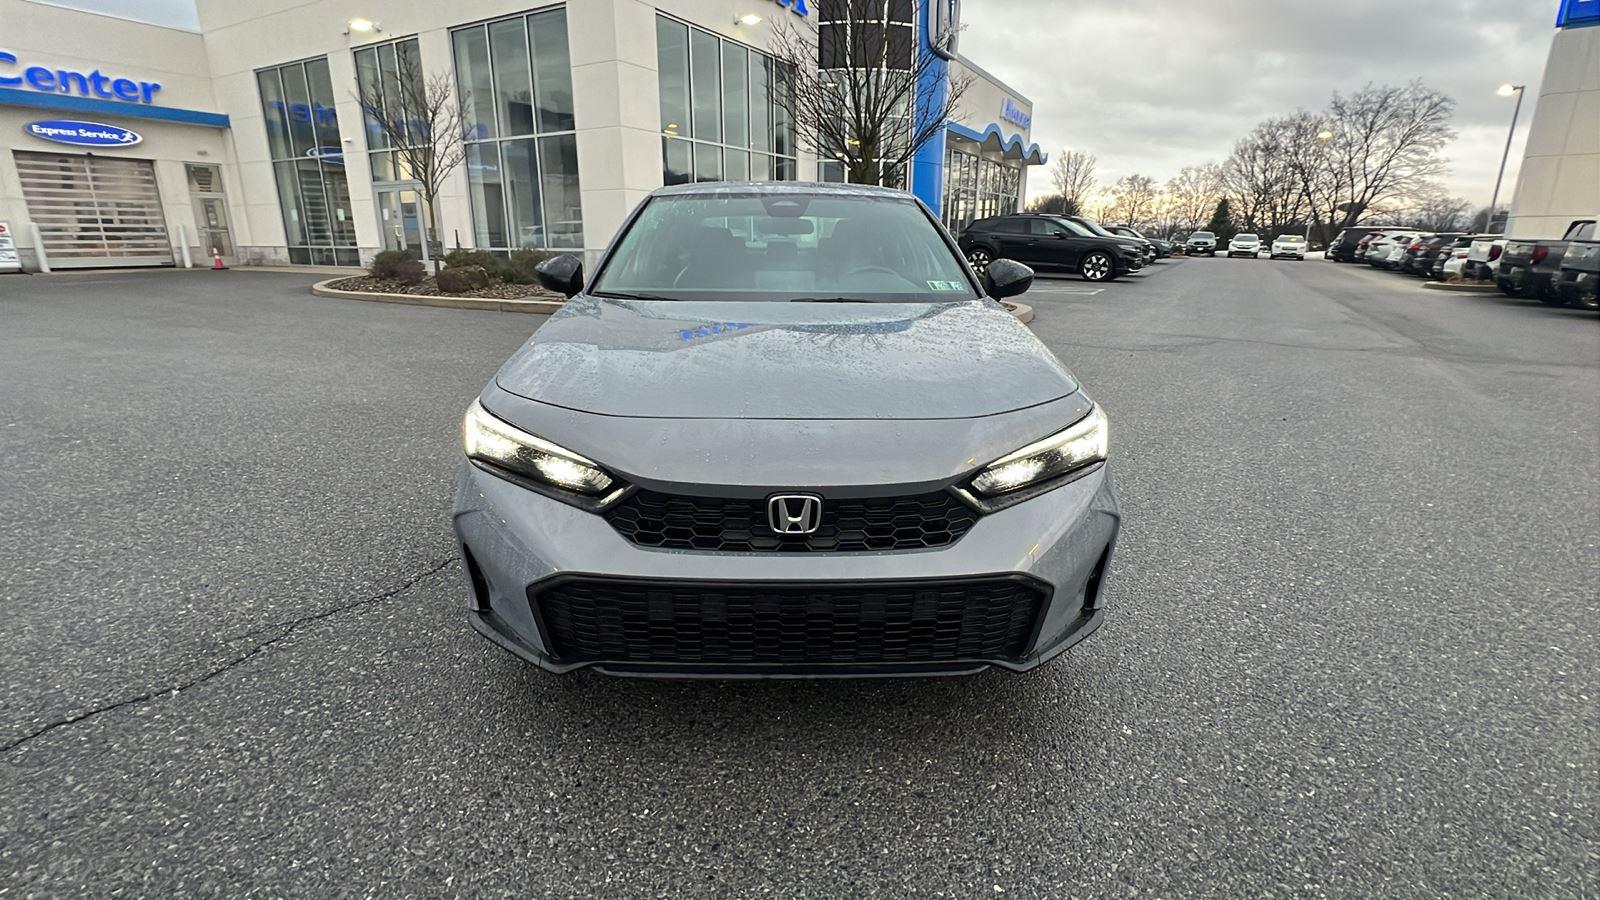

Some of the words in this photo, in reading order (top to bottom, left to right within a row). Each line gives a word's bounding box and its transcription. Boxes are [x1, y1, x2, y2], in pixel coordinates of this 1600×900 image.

[0, 51, 161, 104] Center
[31, 124, 77, 136] Express
[78, 128, 119, 140] Service
